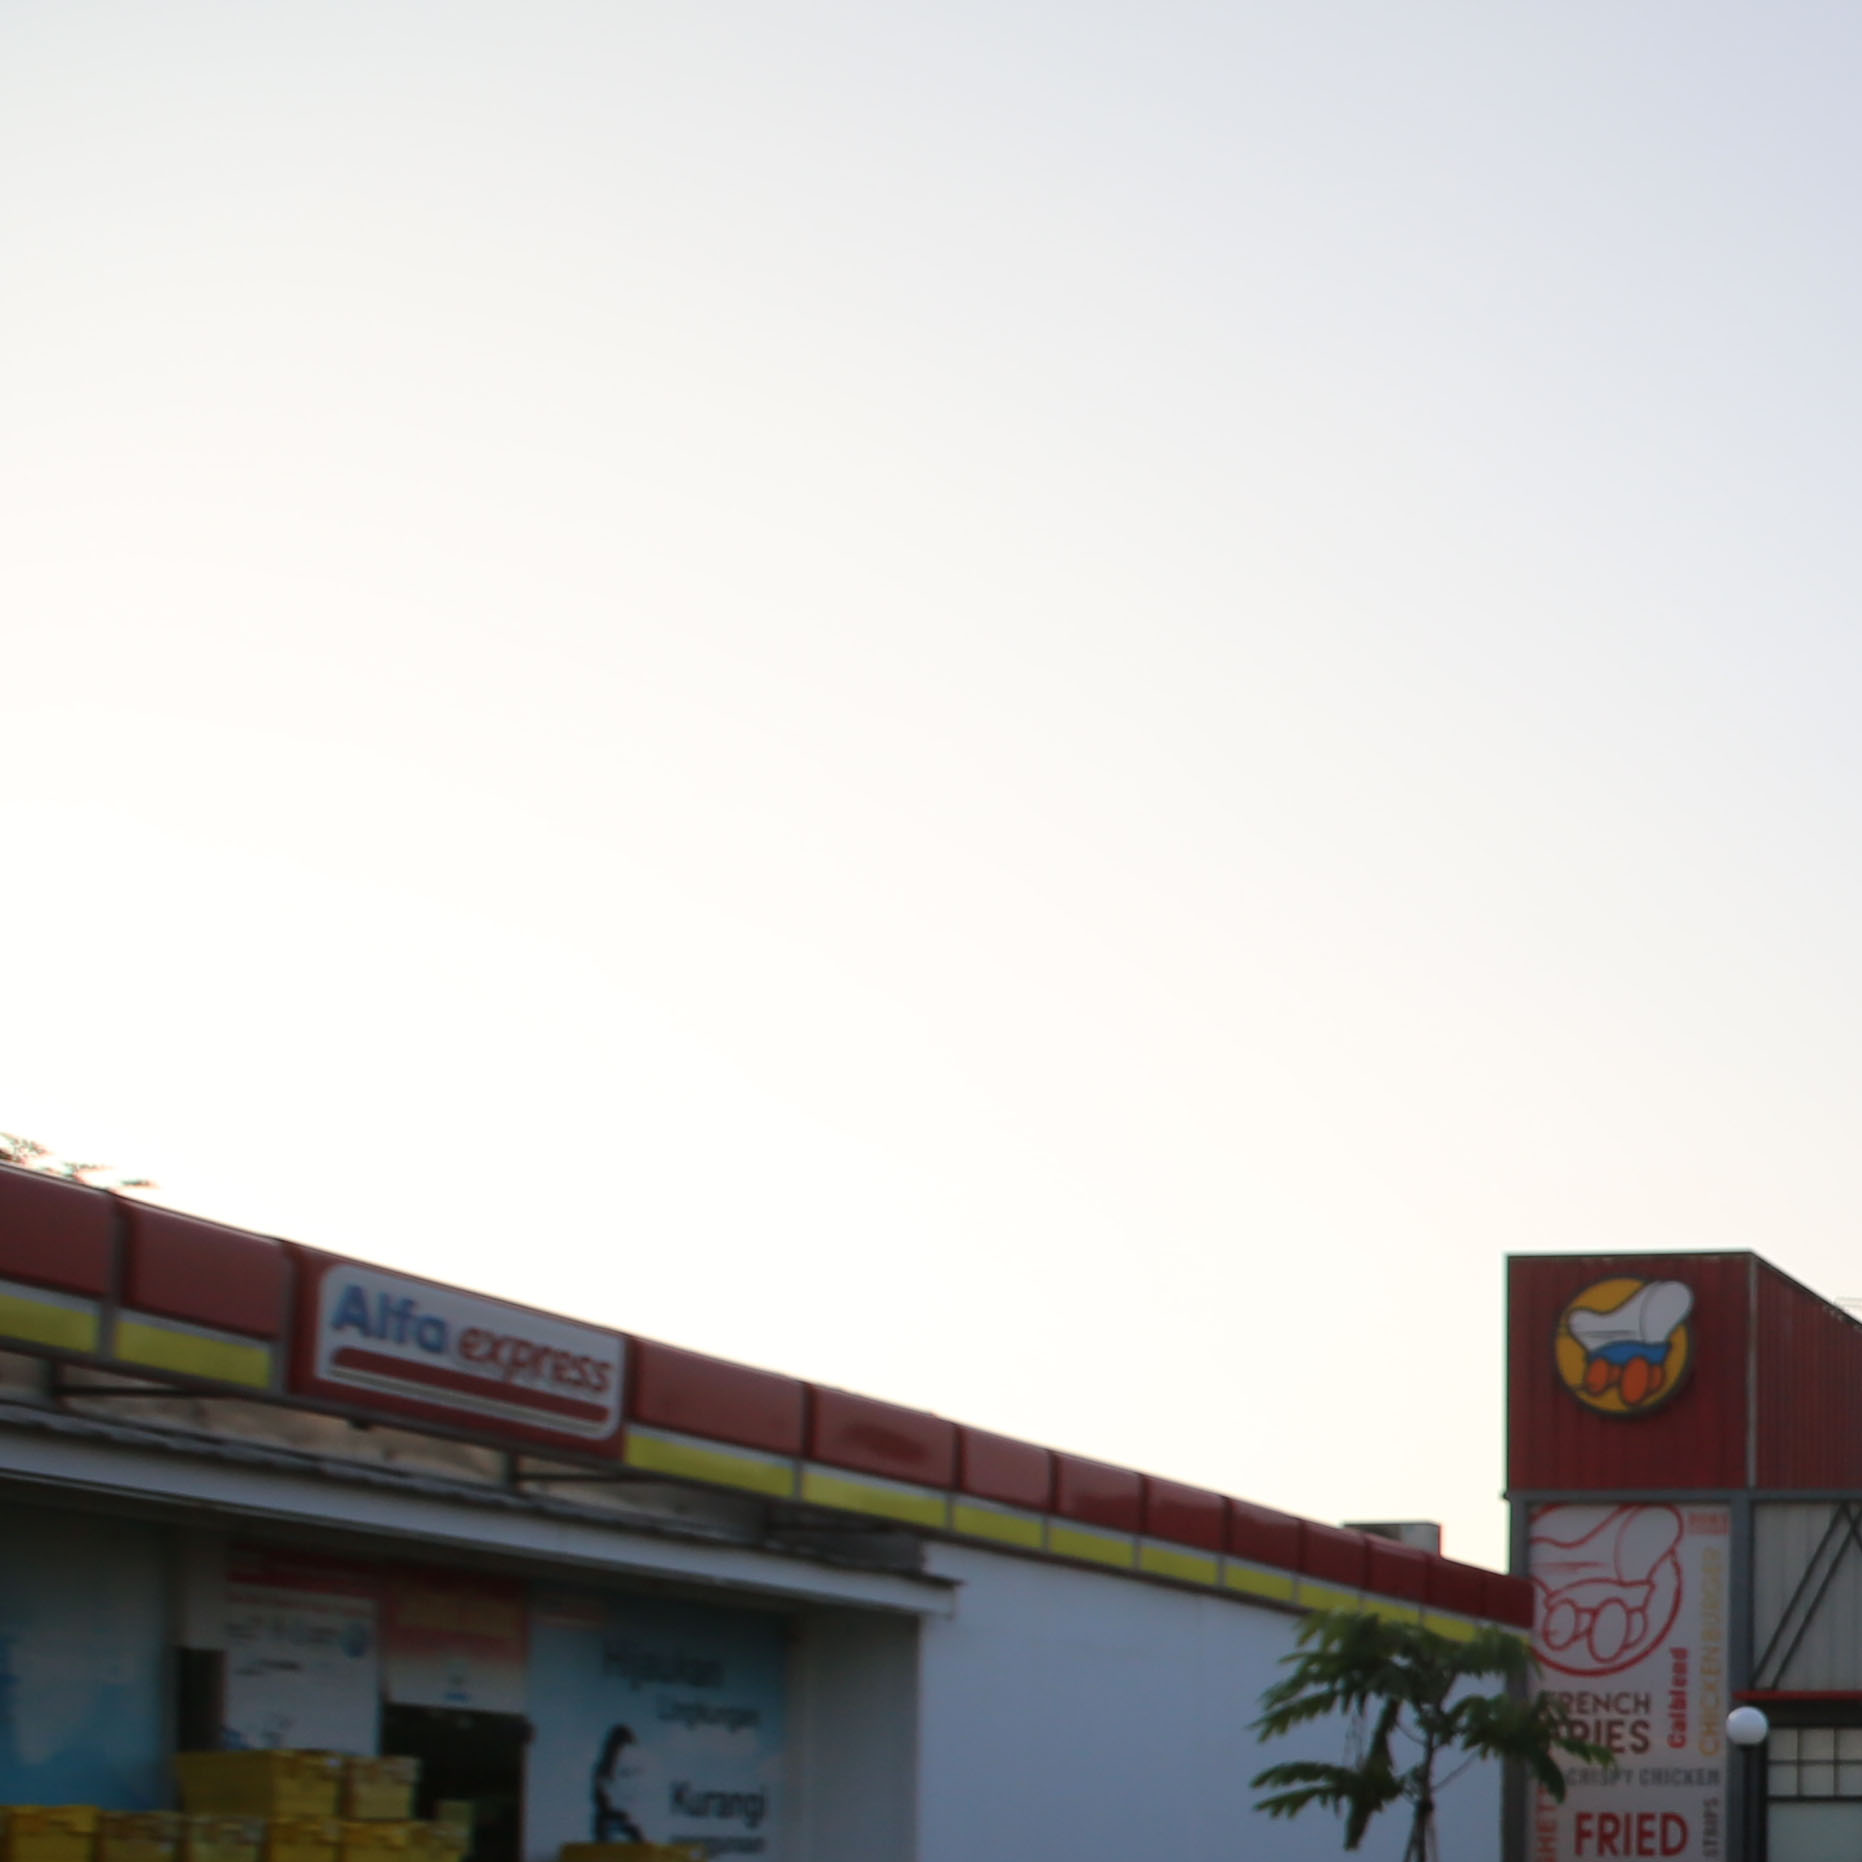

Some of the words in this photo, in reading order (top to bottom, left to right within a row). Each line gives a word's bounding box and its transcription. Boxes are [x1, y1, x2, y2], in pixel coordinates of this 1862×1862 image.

[330, 1284, 448, 1355] Alfa
[457, 1328, 612, 1395] express
[1699, 1646, 1721, 1756] CHICKEN
[1639, 1767, 1720, 1786] CHICKEN
[1574, 1811, 1689, 1858] FRIED
